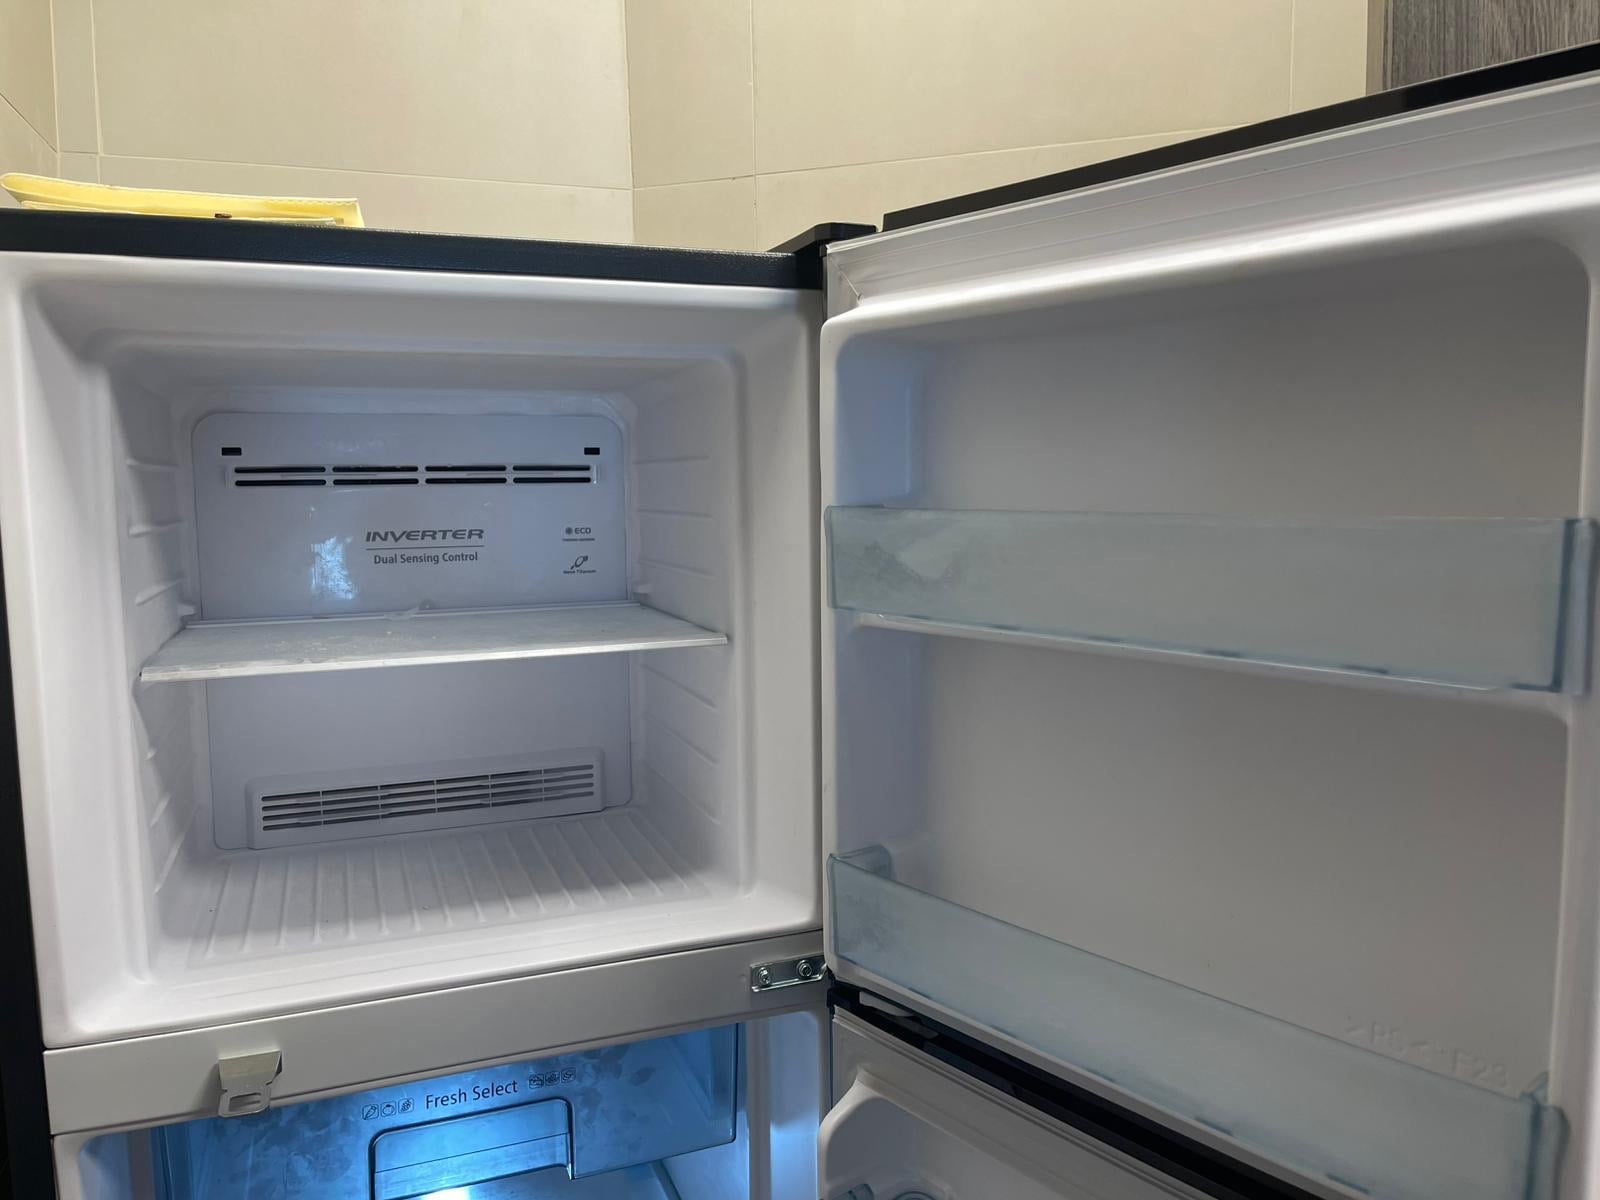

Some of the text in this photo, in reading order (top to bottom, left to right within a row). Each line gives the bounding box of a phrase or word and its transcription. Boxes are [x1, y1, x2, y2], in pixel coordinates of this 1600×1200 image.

[365, 529, 484, 543] INVERTER
[574, 527, 592, 535] ECO
[374, 552, 478, 565] Dual Sensing Control
[425, 1080, 518, 1110] Fresh Select
